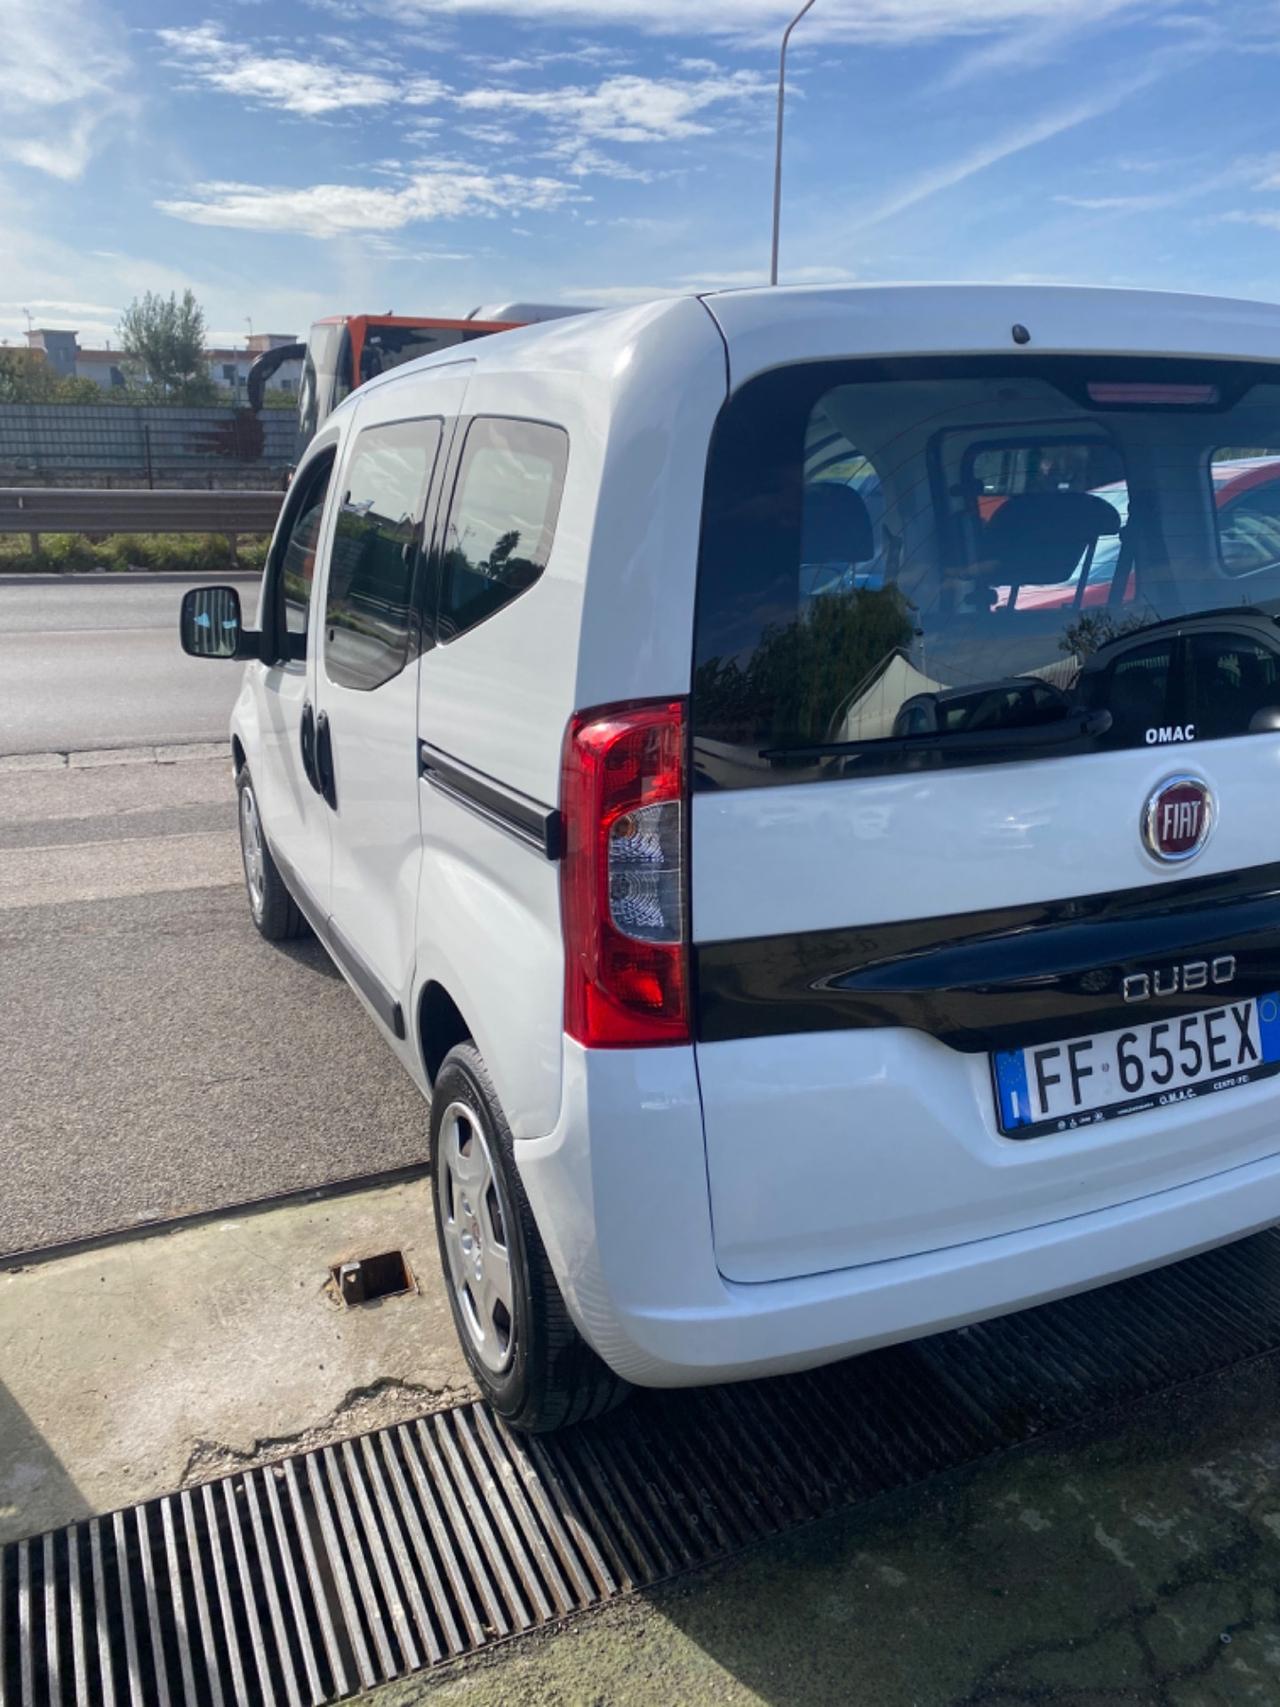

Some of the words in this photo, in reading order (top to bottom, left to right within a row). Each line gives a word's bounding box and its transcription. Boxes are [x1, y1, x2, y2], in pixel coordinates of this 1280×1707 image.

[1145, 724, 1195, 744] OMAC
[1162, 800, 1201, 841] FIAT
[1123, 955, 1236, 1002] QUBO
[1034, 1040, 1093, 1114] FF
[1117, 1002, 1259, 1093] 655EX
